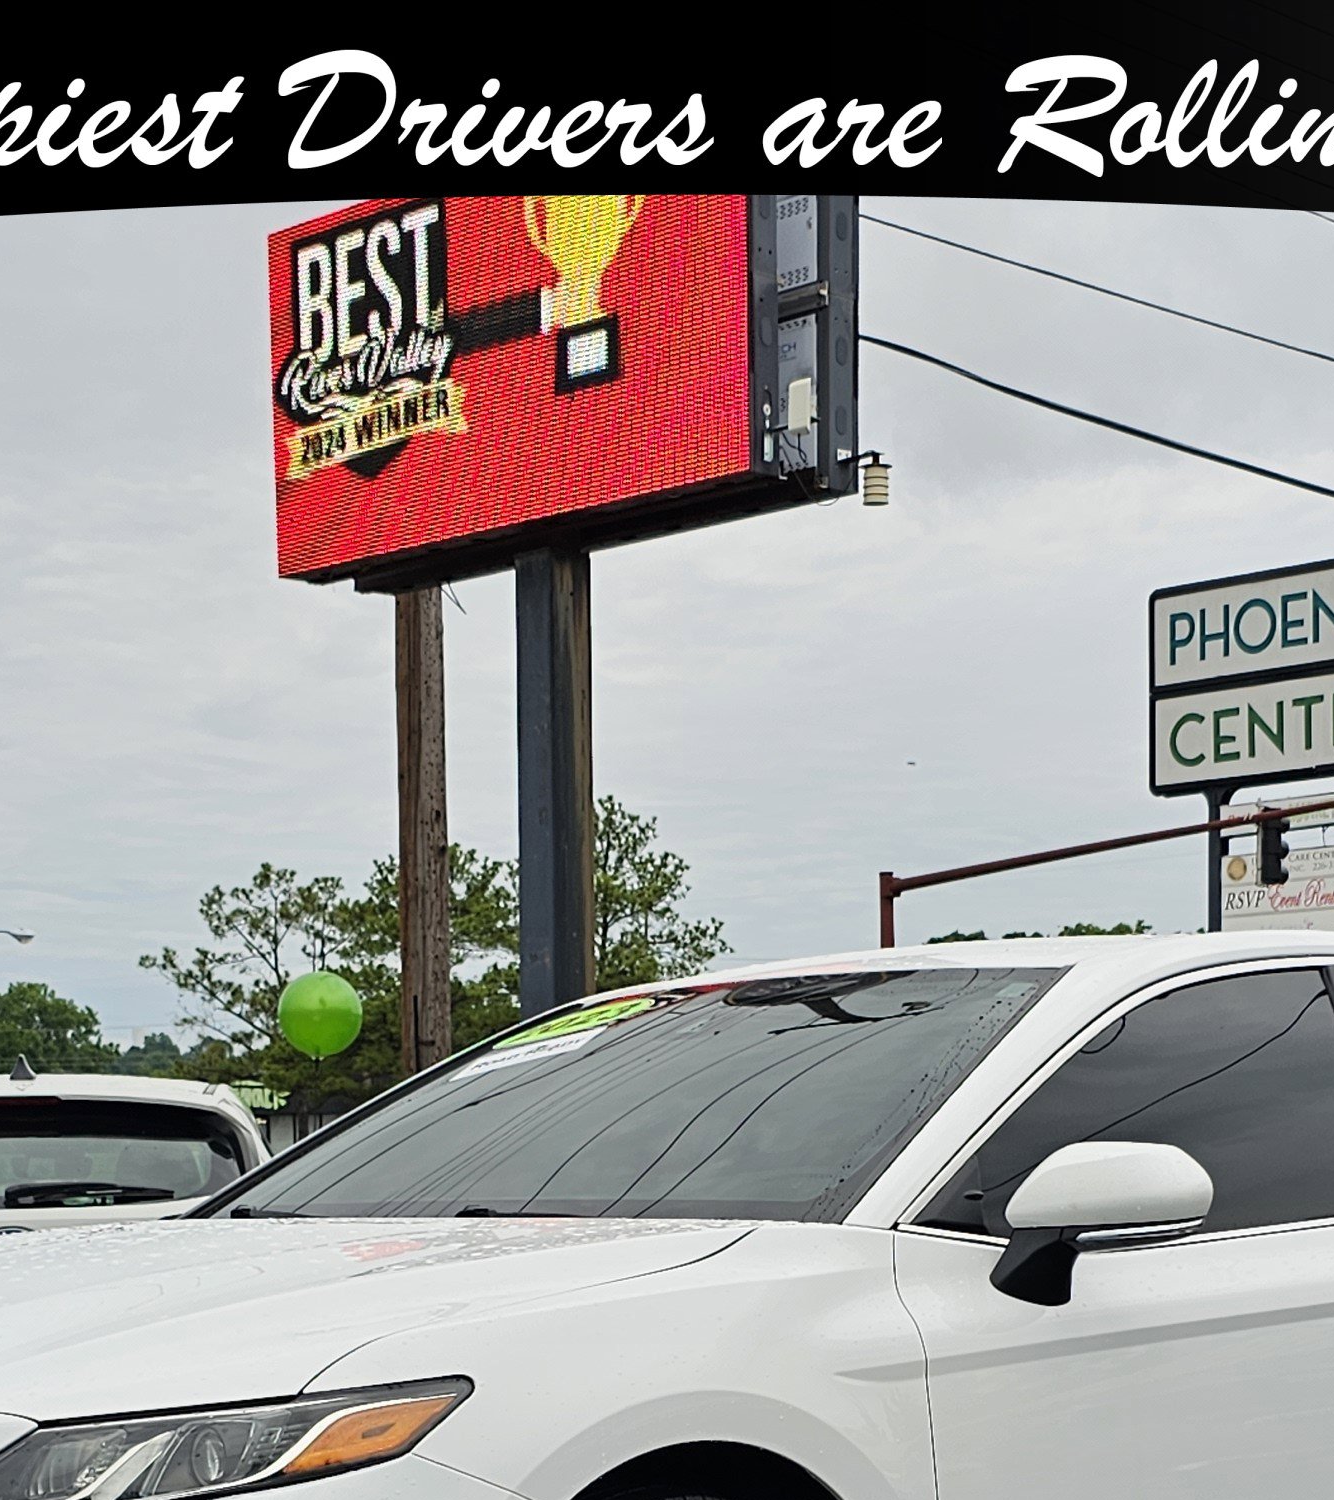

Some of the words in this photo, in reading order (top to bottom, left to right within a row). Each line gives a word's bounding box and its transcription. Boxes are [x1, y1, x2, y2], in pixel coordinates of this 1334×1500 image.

[297, 203, 439, 360] BEST
[355, 388, 450, 449] WINNER
[1225, 890, 1266, 911] RSVP
[1268, 884, 1302, 912] Event
